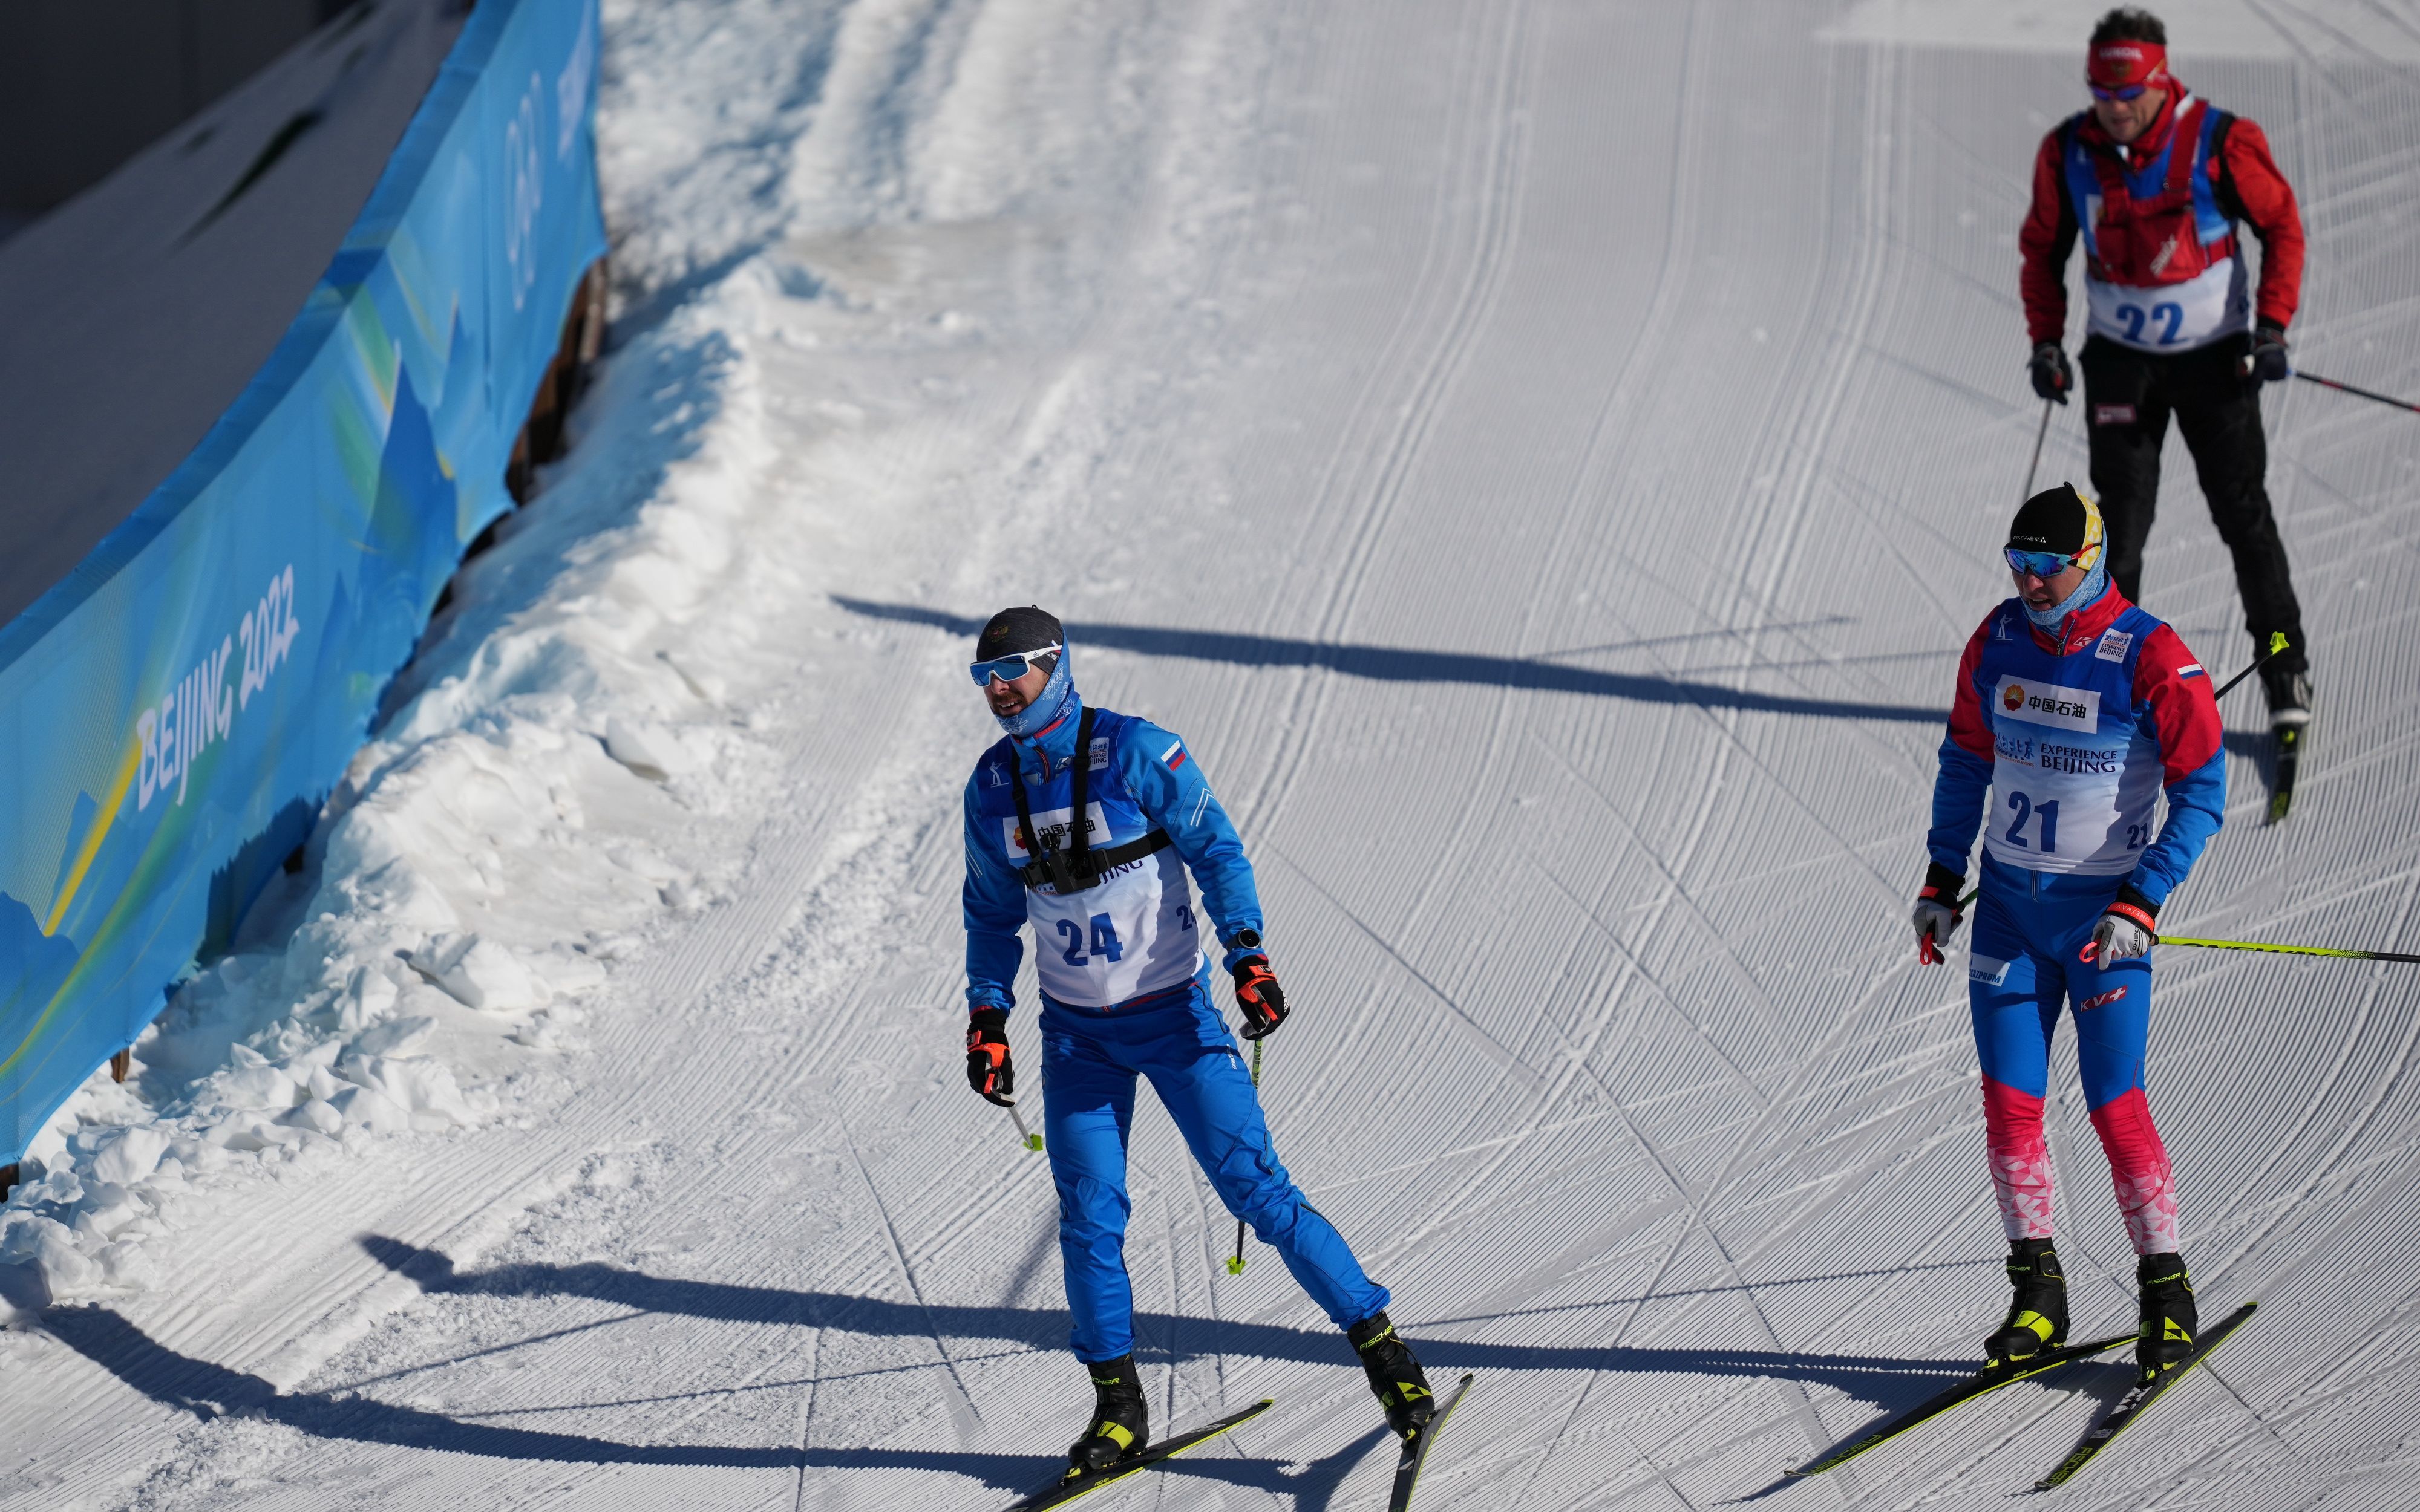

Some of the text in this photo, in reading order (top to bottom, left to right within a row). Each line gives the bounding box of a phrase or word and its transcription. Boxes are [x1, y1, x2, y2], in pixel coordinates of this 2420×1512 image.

[2116, 302, 2189, 345] 22
[2099, 647, 2124, 658] BEIJING
[2102, 643, 2125, 653] EXPERIENCE
[136, 563, 301, 812] BEIJING 2022
[2029, 696, 2087, 719] 中国石油
[1089, 757, 1107, 765] EIJING
[2041, 743, 2118, 760] EXPERIENCE
[2041, 754, 2116, 774] BEIJING
[2005, 790, 2059, 853] 21
[1102, 859, 1143, 884] JING
[1056, 911, 1123, 966] 24
[2147, 1272, 2181, 1285] FISCHER
[1091, 1377, 1120, 1385] CHER
[2047, 1447, 2094, 1484] FISCHER
